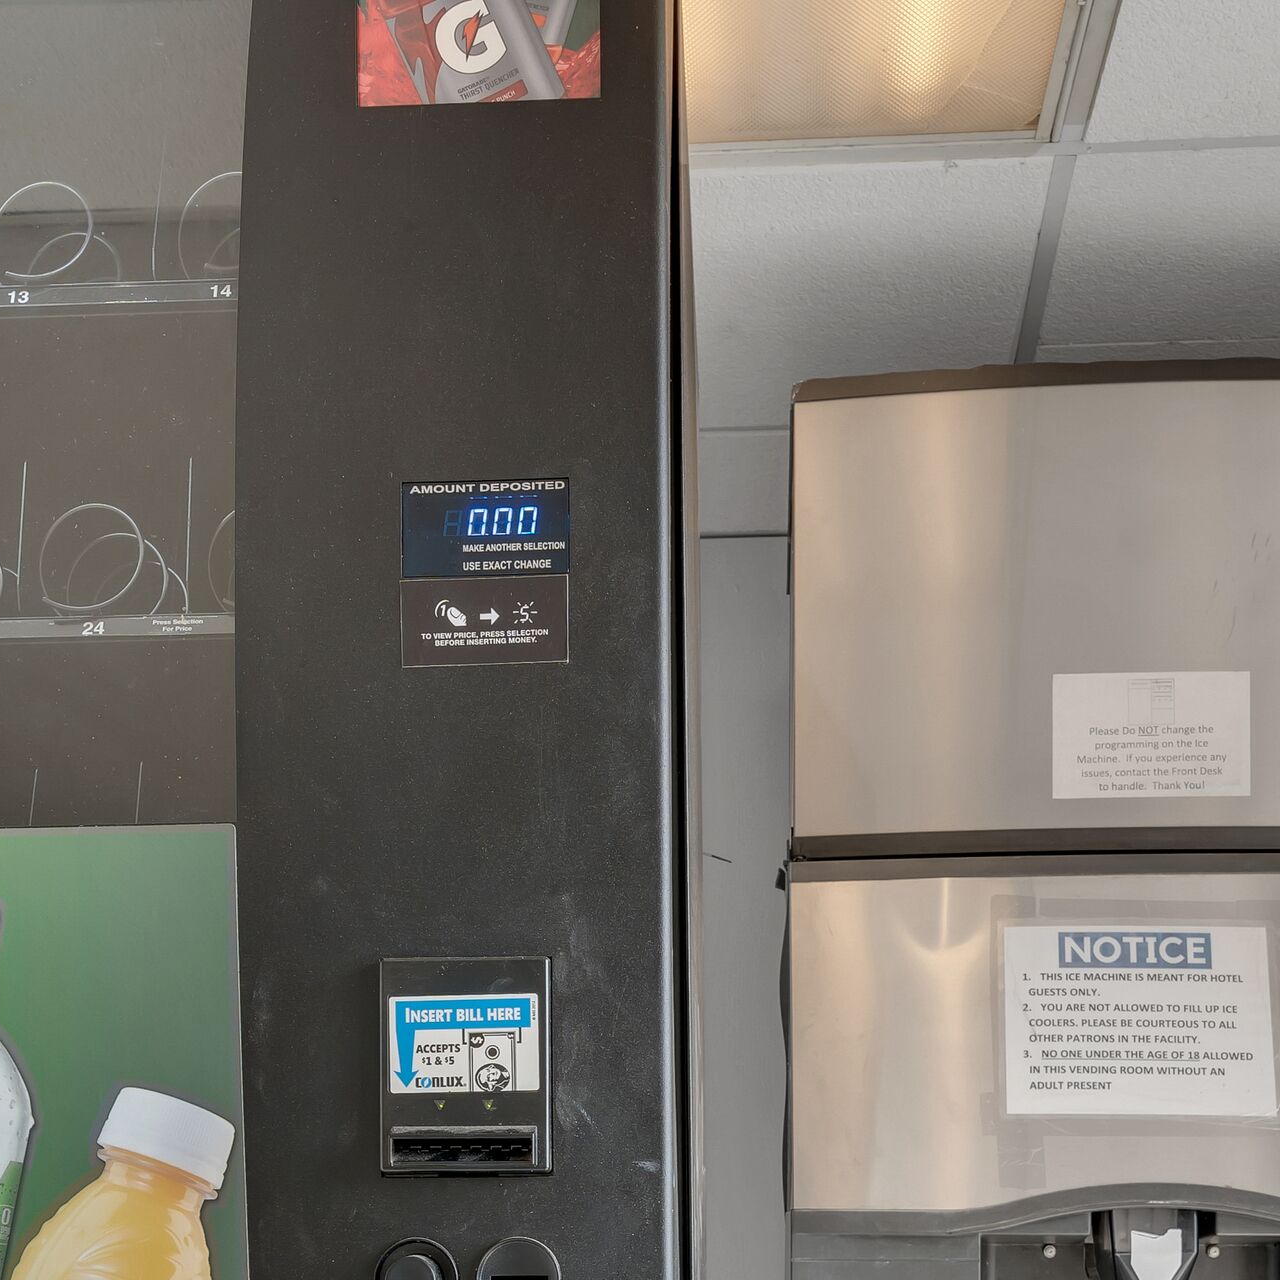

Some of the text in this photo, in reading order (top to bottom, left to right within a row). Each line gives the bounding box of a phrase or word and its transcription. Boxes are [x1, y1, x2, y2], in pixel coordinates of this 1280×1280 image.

[210, 284, 232, 298] 14
[8, 290, 30, 304] 13
[409, 481, 565, 494] AMOUNT DEPOSITED
[467, 506, 538, 536] 0.00
[462, 541, 565, 553] MAKE ANOTHER SELECTION
[463, 559, 552, 571] USE EXACT CHANGE
[81, 621, 105, 635] 24
[421, 632, 432, 640] TO
[453, 631, 478, 640] PRICE,
[480, 630, 505, 638] PRESS
[506, 629, 549, 637] SELECTION
[434, 639, 465, 647] BEFORE
[508, 636, 537, 644] MONEY.
[1089, 725, 1195, 736] Please Do NOT change
[1094, 739, 1192, 751] programming the
[1077, 753, 1227, 764] Machine. you experience any
[1081, 767, 1222, 779] issues, contact the Front Desk
[1111, 781, 1205, 791] handle. Thank You!
[1064, 936, 1207, 964] NOTICE
[1041, 973, 1244, 983] THIS ICE MACHINE IS MEANT FOR HOTEL
[1028, 988, 1100, 996] GUESTS ONLY.
[1040, 1004, 1238, 1013] YOU ARE NOT ALLOWED TO FILL UP ICE
[405, 1007, 453, 1023] INSERT
[456, 1008, 484, 1022] BILL
[487, 1007, 521, 1021] HERE
[1028, 1019, 1237, 1029] COOLERS. PLEASE BE COURTEOUS TO ALL
[1029, 1034, 1200, 1044] OTHER PATRONS IN THE FACILITY.
[415, 1044, 461, 1054] ACCEPTS
[1041, 1050, 1253, 1060] NO ONE UNDER THE AGE OF 18 ALLOWED
[1029, 1066, 1225, 1076] IN THIS VENDING ROOM WITHOUT AN
[1029, 1082, 1112, 1090] ADULT PRESENT
